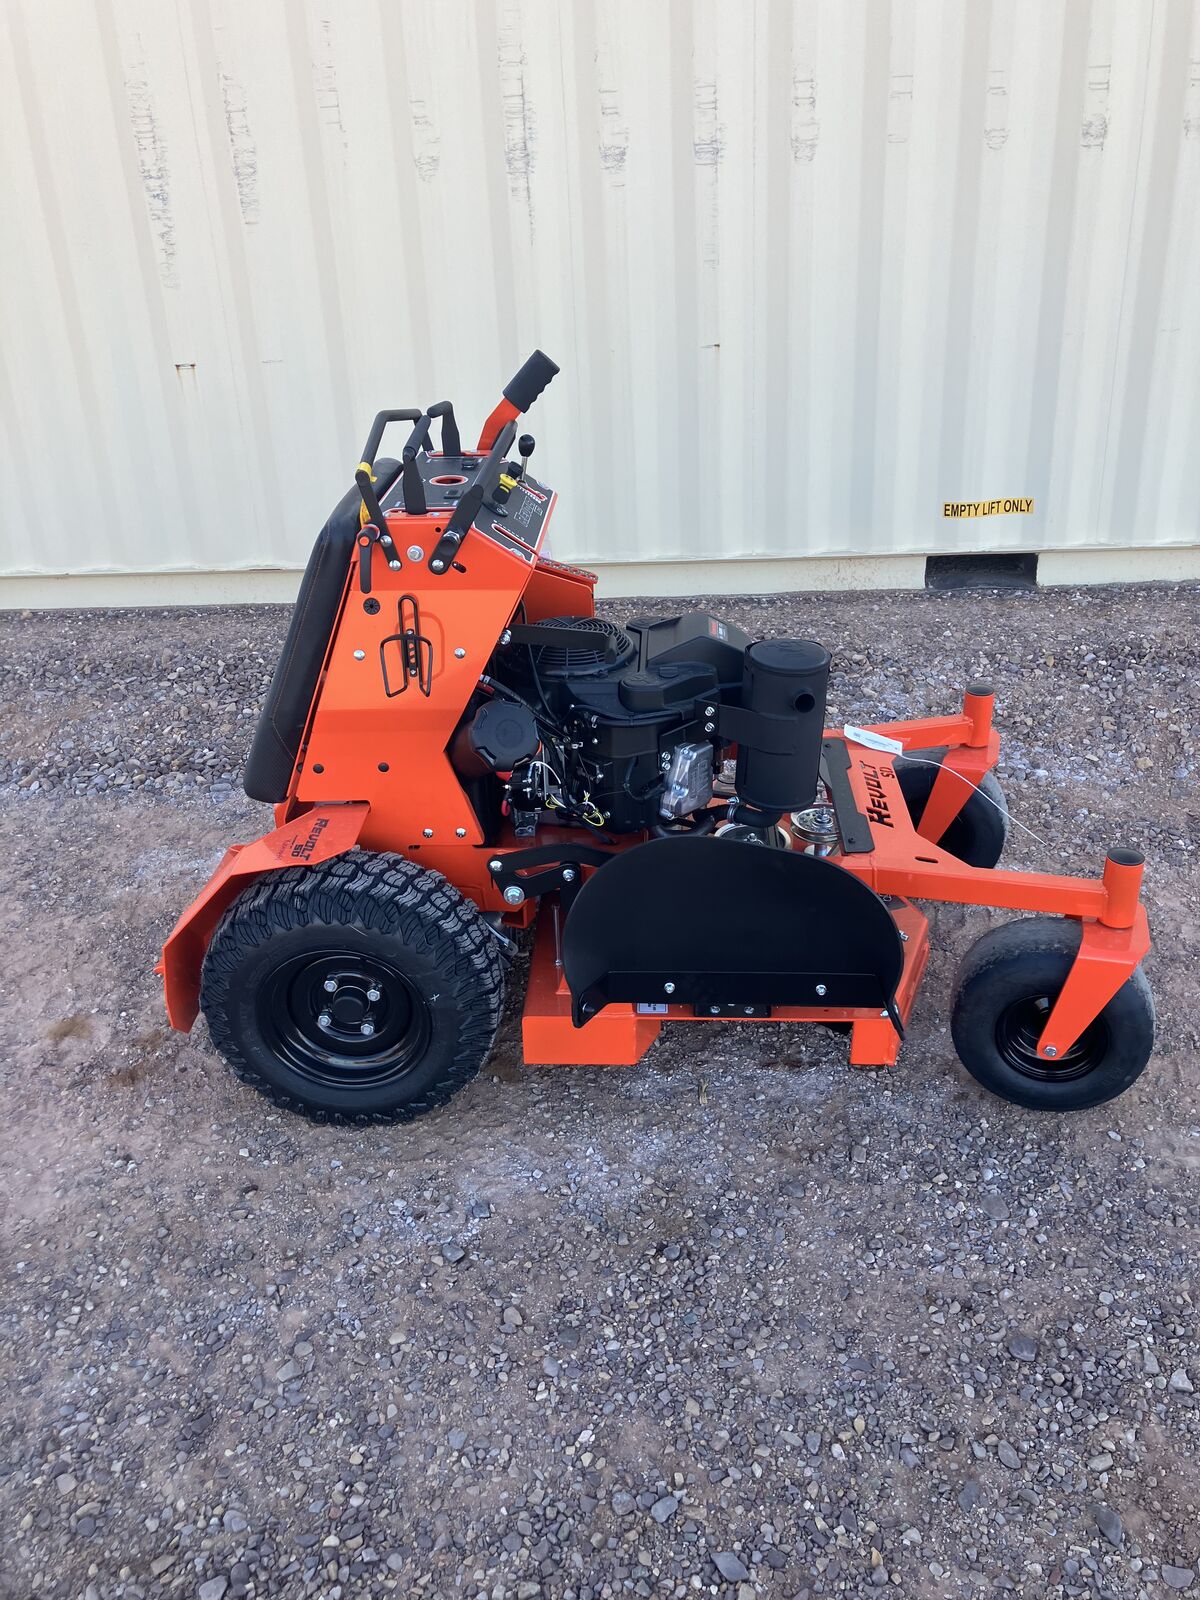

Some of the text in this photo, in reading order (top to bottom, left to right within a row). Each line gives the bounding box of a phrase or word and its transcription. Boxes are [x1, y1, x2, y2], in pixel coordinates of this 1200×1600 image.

[943, 499, 1033, 517] EMPTY LIFT ONLY
[879, 766, 895, 779] SD
[299, 818, 330, 861] REVOLT
[291, 844, 304, 858] SD
